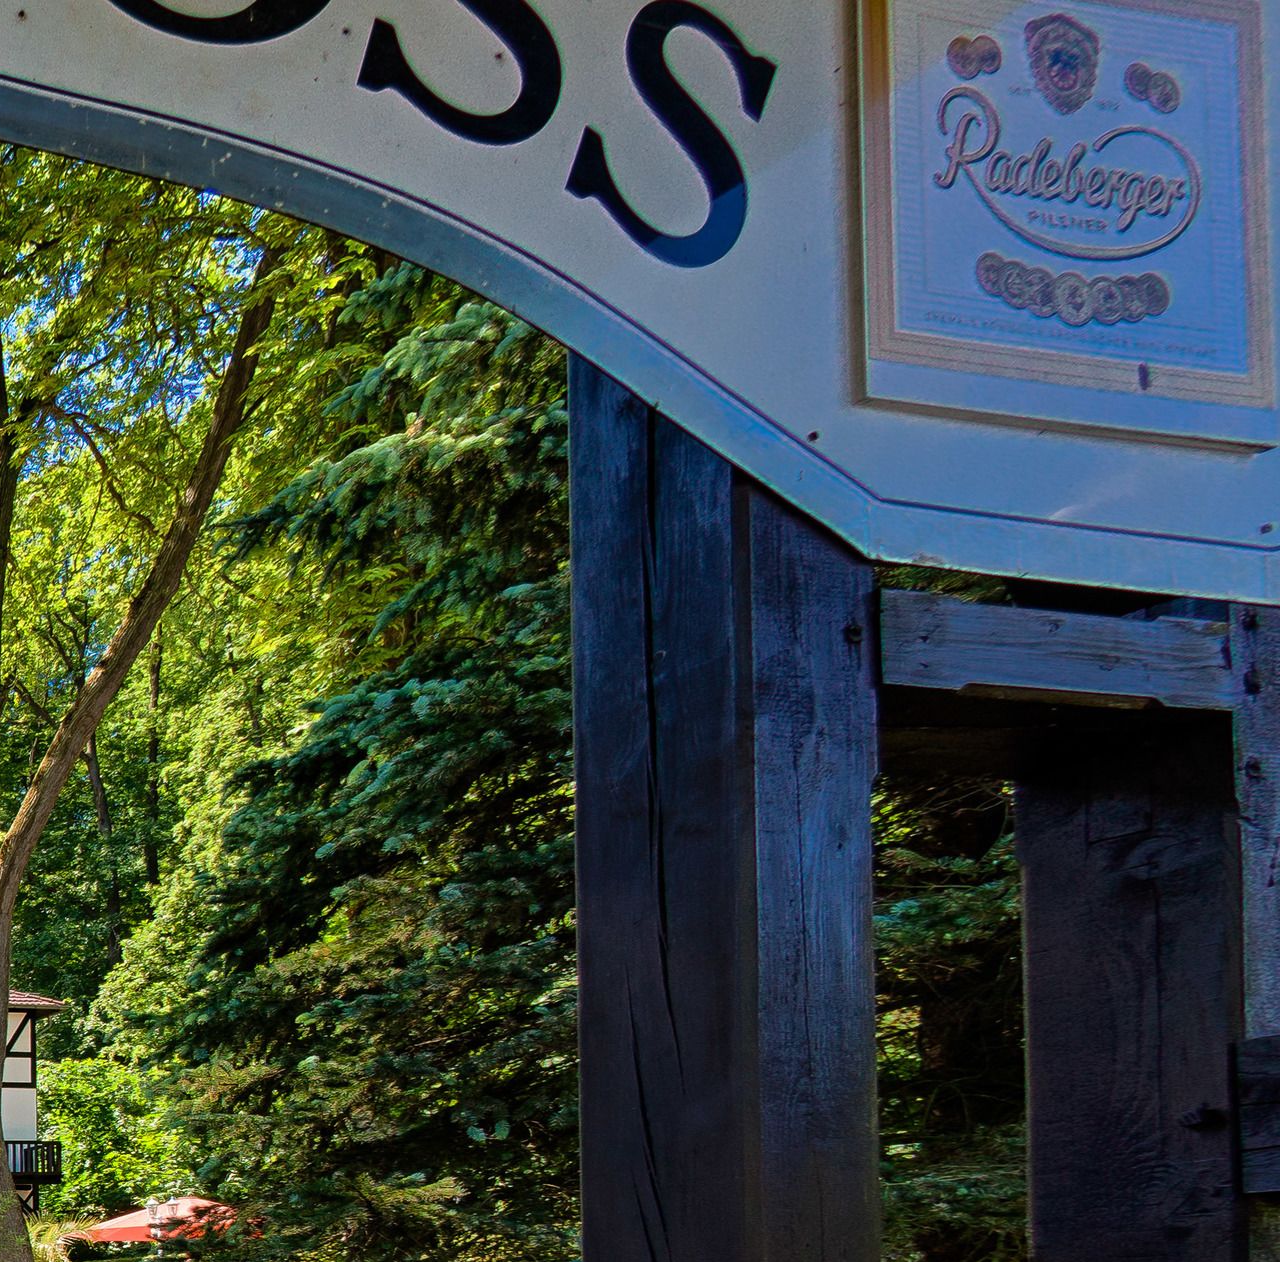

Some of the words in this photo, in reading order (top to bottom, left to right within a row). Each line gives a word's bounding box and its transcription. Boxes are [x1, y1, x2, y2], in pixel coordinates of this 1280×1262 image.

[104, 0, 778, 268] SS
[933, 85, 1188, 233] Radeberger
[1027, 209, 1109, 233] PILSNER
